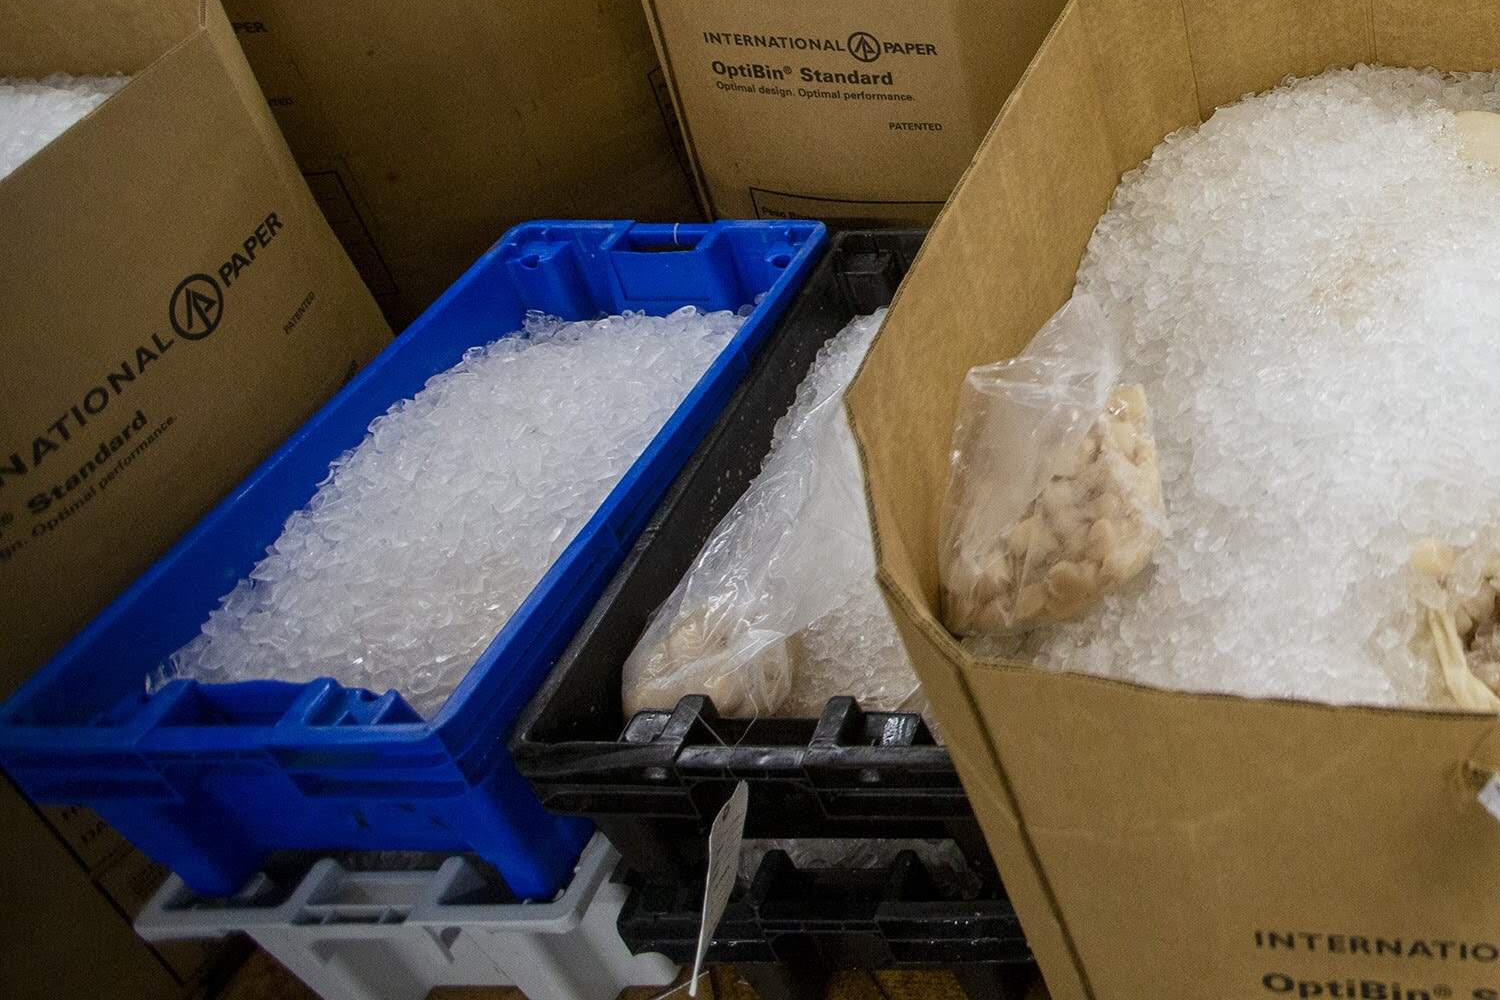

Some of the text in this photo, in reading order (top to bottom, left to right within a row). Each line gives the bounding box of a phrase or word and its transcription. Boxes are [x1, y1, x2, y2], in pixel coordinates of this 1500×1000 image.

[231, 22, 269, 33] PER
[703, 31, 938, 56] INTERNATIONAL PAPER
[711, 60, 894, 86] OptiBin® Standard
[716, 80, 917, 103] Optimal design. Optimal performance.
[888, 121, 943, 132] PATENTED
[217, 211, 285, 288] PAPER
[283, 291, 316, 336] PATENTED
[27, 408, 149, 515] Standard
[31, 484, 97, 539] Optimal
[98, 414, 178, 491] performance.
